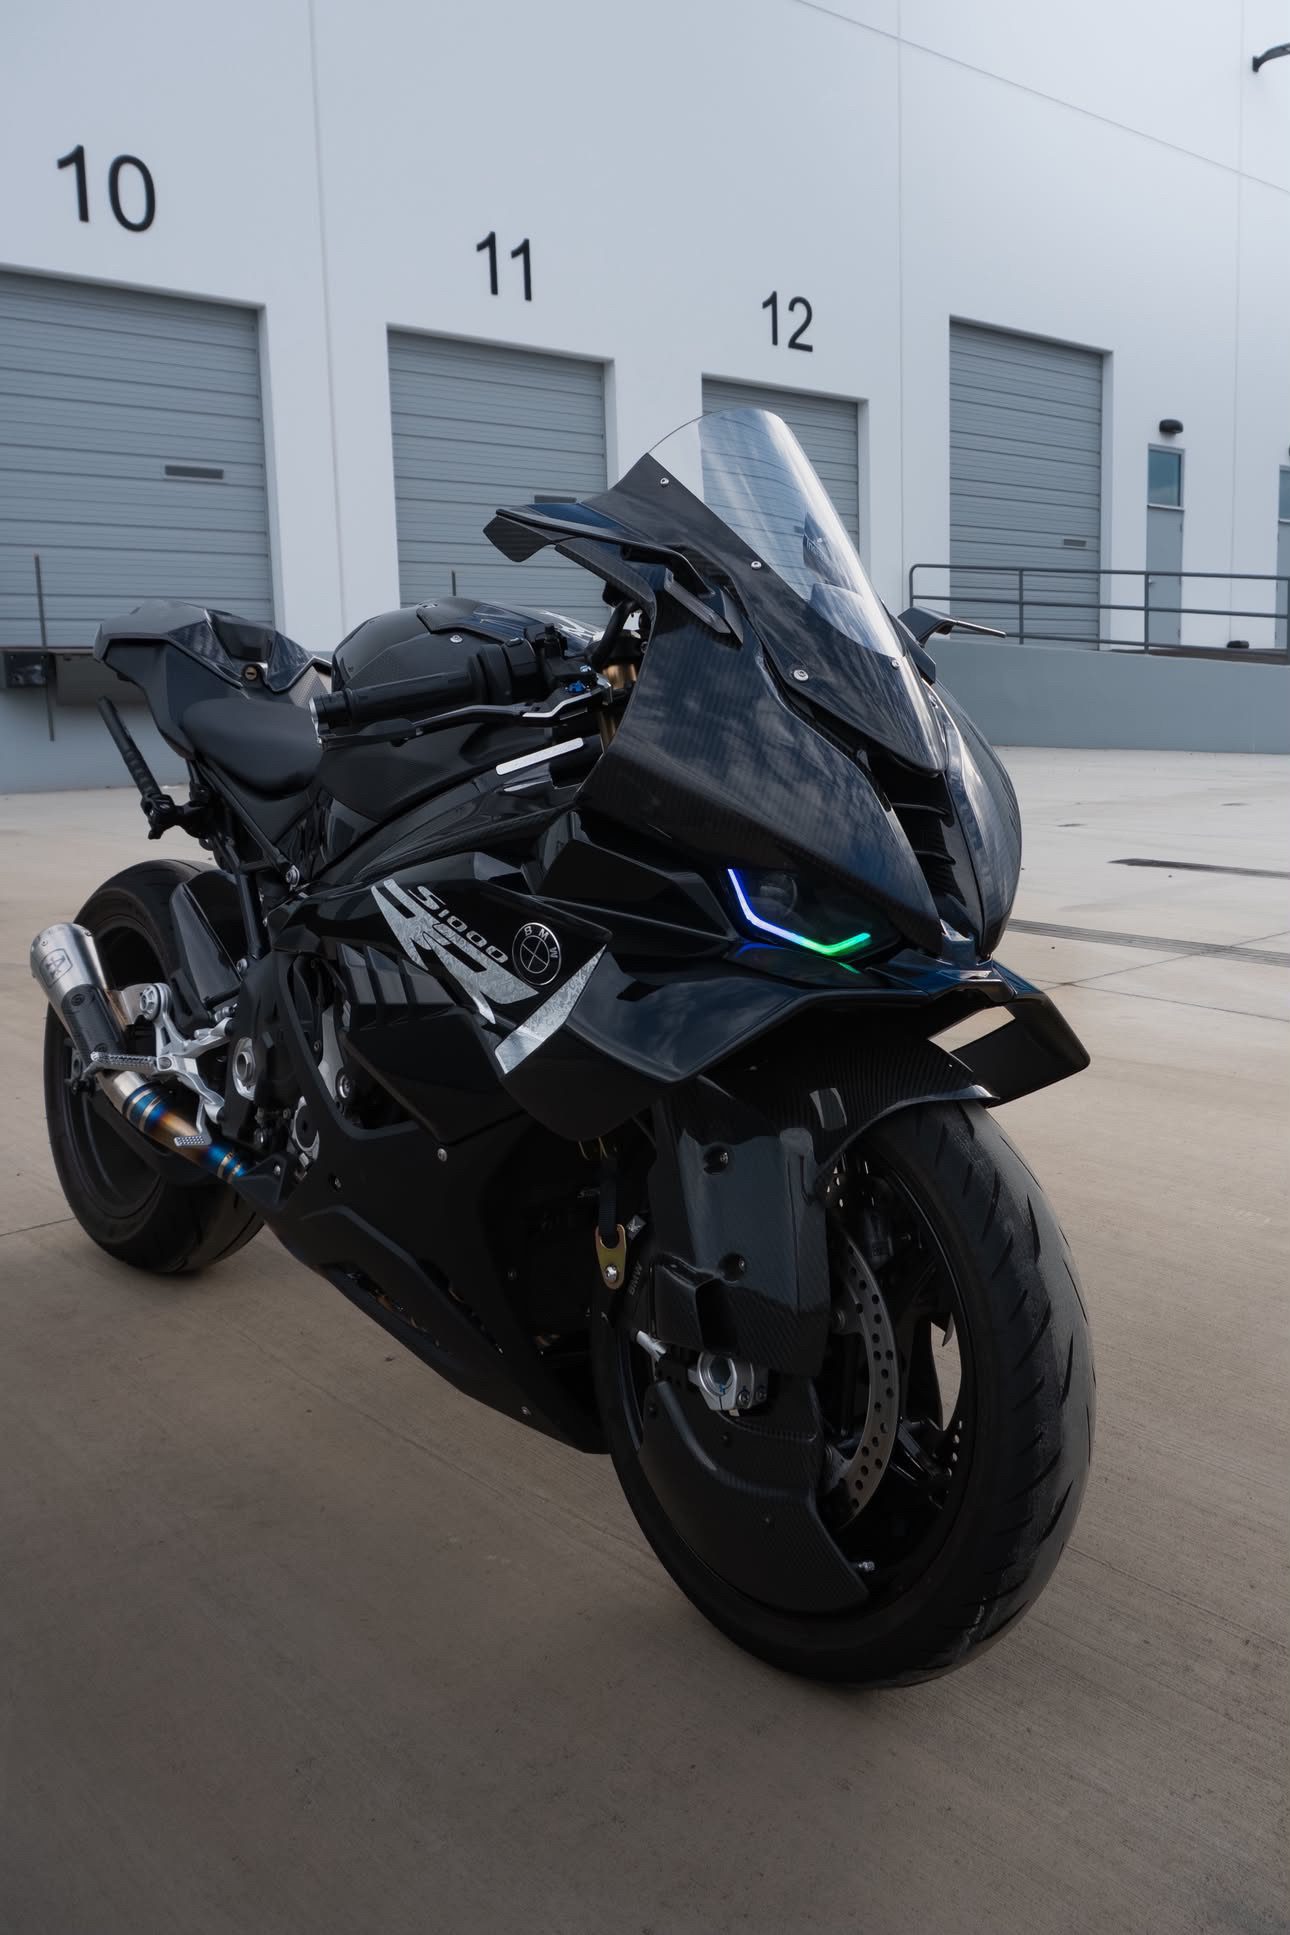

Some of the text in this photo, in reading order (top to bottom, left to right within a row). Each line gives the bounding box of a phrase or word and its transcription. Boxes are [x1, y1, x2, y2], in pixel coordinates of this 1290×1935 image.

[57, 144, 156, 232] 10
[476, 231, 532, 302] 11
[762, 290, 813, 352] 12
[524, 925, 559, 958] BMW
